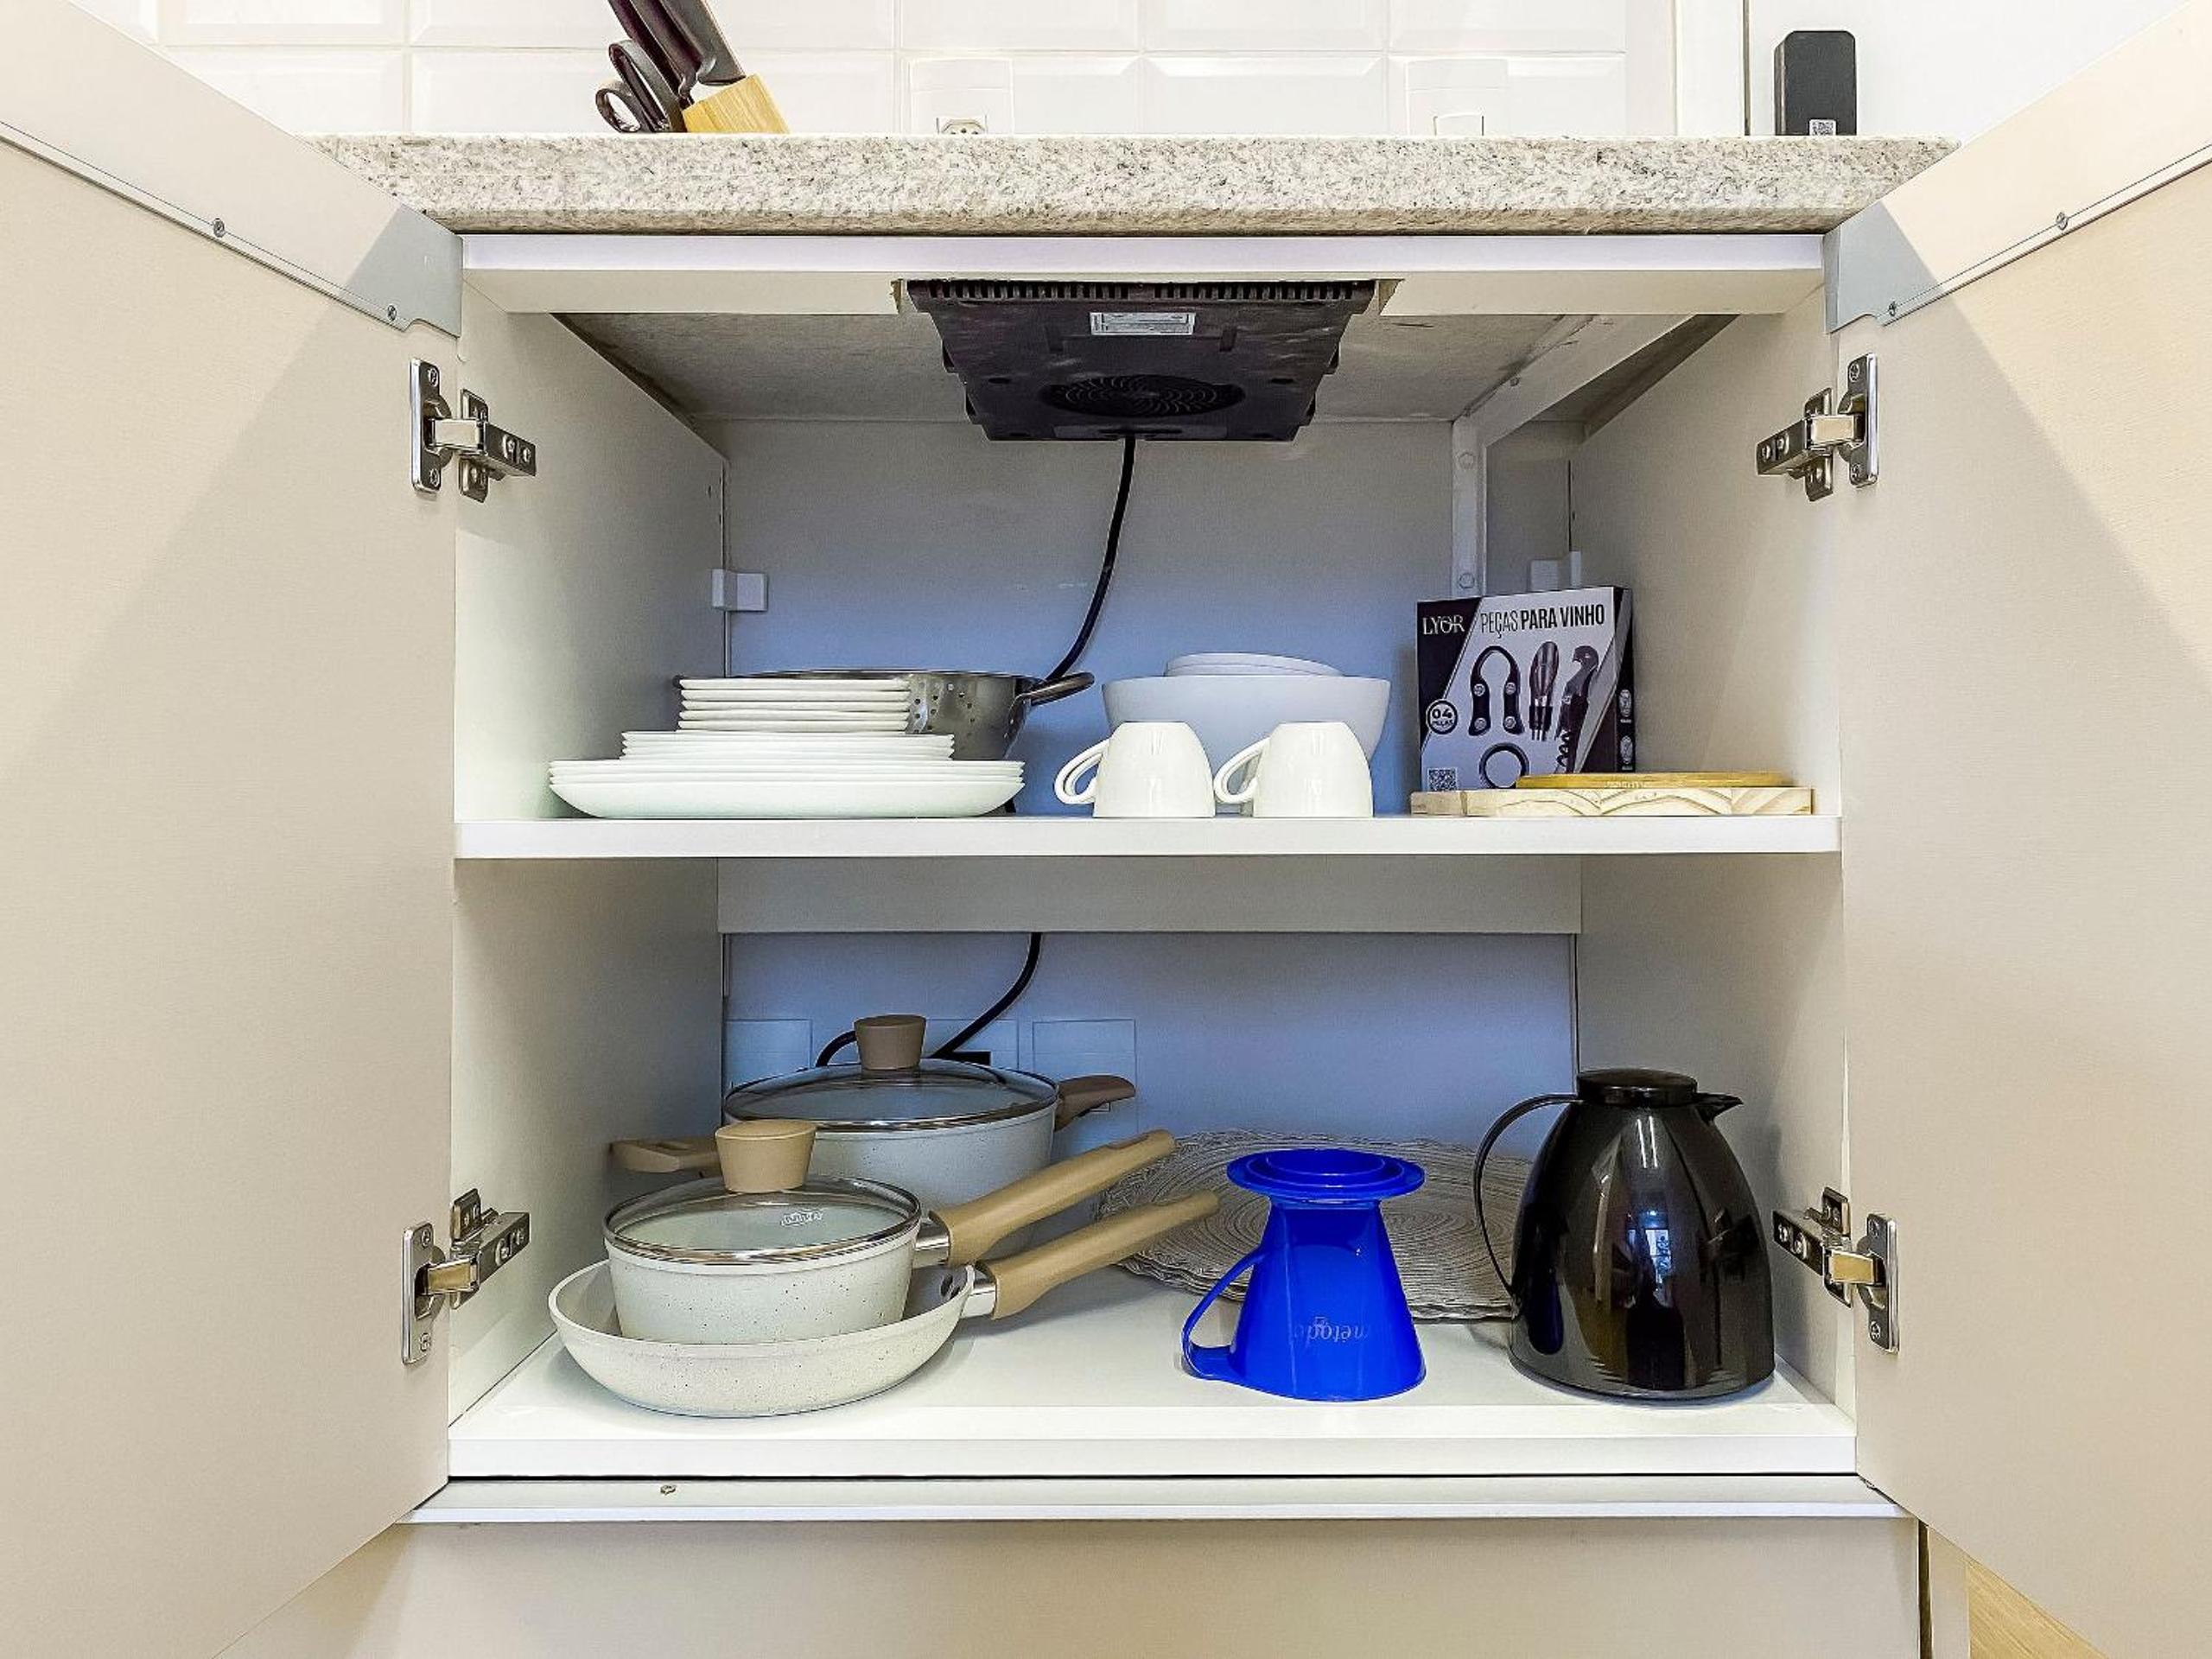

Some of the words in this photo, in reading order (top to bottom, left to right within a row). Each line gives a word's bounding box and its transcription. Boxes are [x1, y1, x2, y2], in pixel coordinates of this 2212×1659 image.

[1481, 610, 1519, 639] PEÇAS
[1521, 607, 1558, 630] PARA
[1560, 604, 1605, 627] VINHO
[1432, 709, 1453, 719] 04
